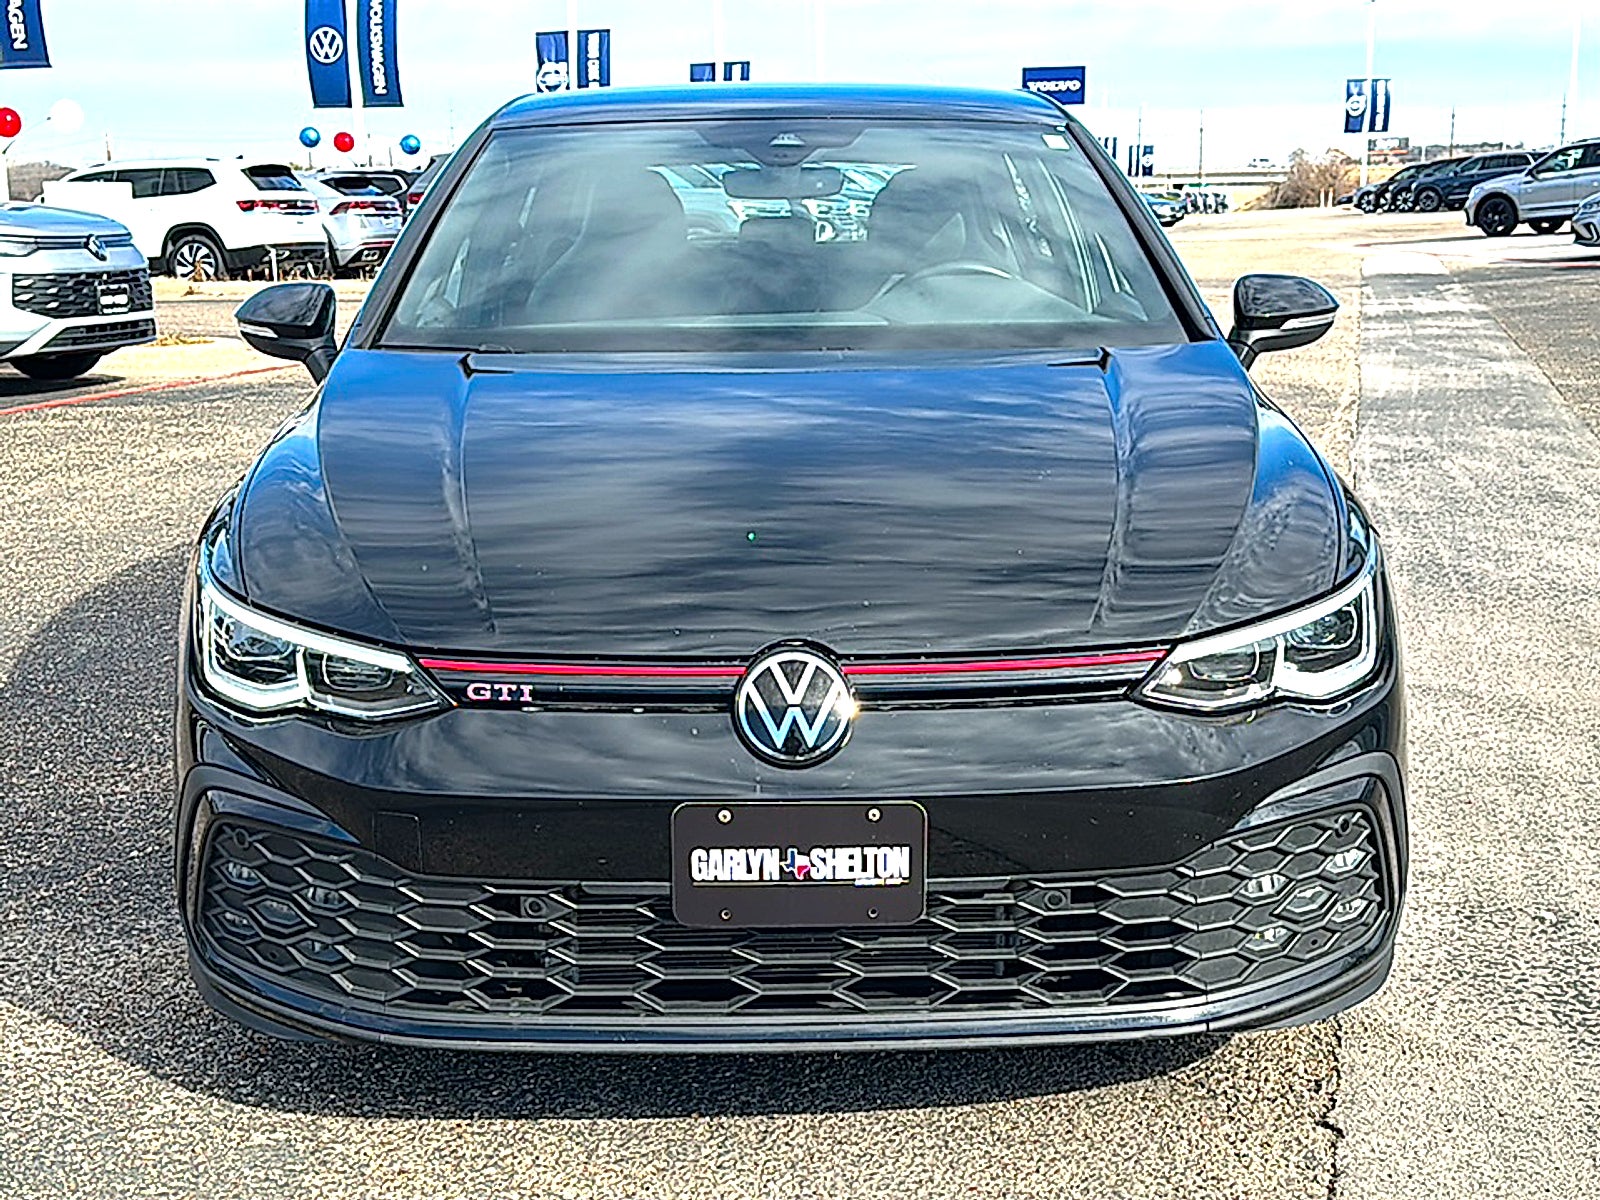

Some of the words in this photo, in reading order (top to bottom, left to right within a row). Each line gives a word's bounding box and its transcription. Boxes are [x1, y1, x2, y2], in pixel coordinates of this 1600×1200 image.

[1026, 79, 1081, 92] VOLVO
[466, 683, 535, 703] GTI
[738, 651, 853, 761] VW
[691, 848, 780, 881] GARLYN
[810, 846, 910, 881] SHELTON
